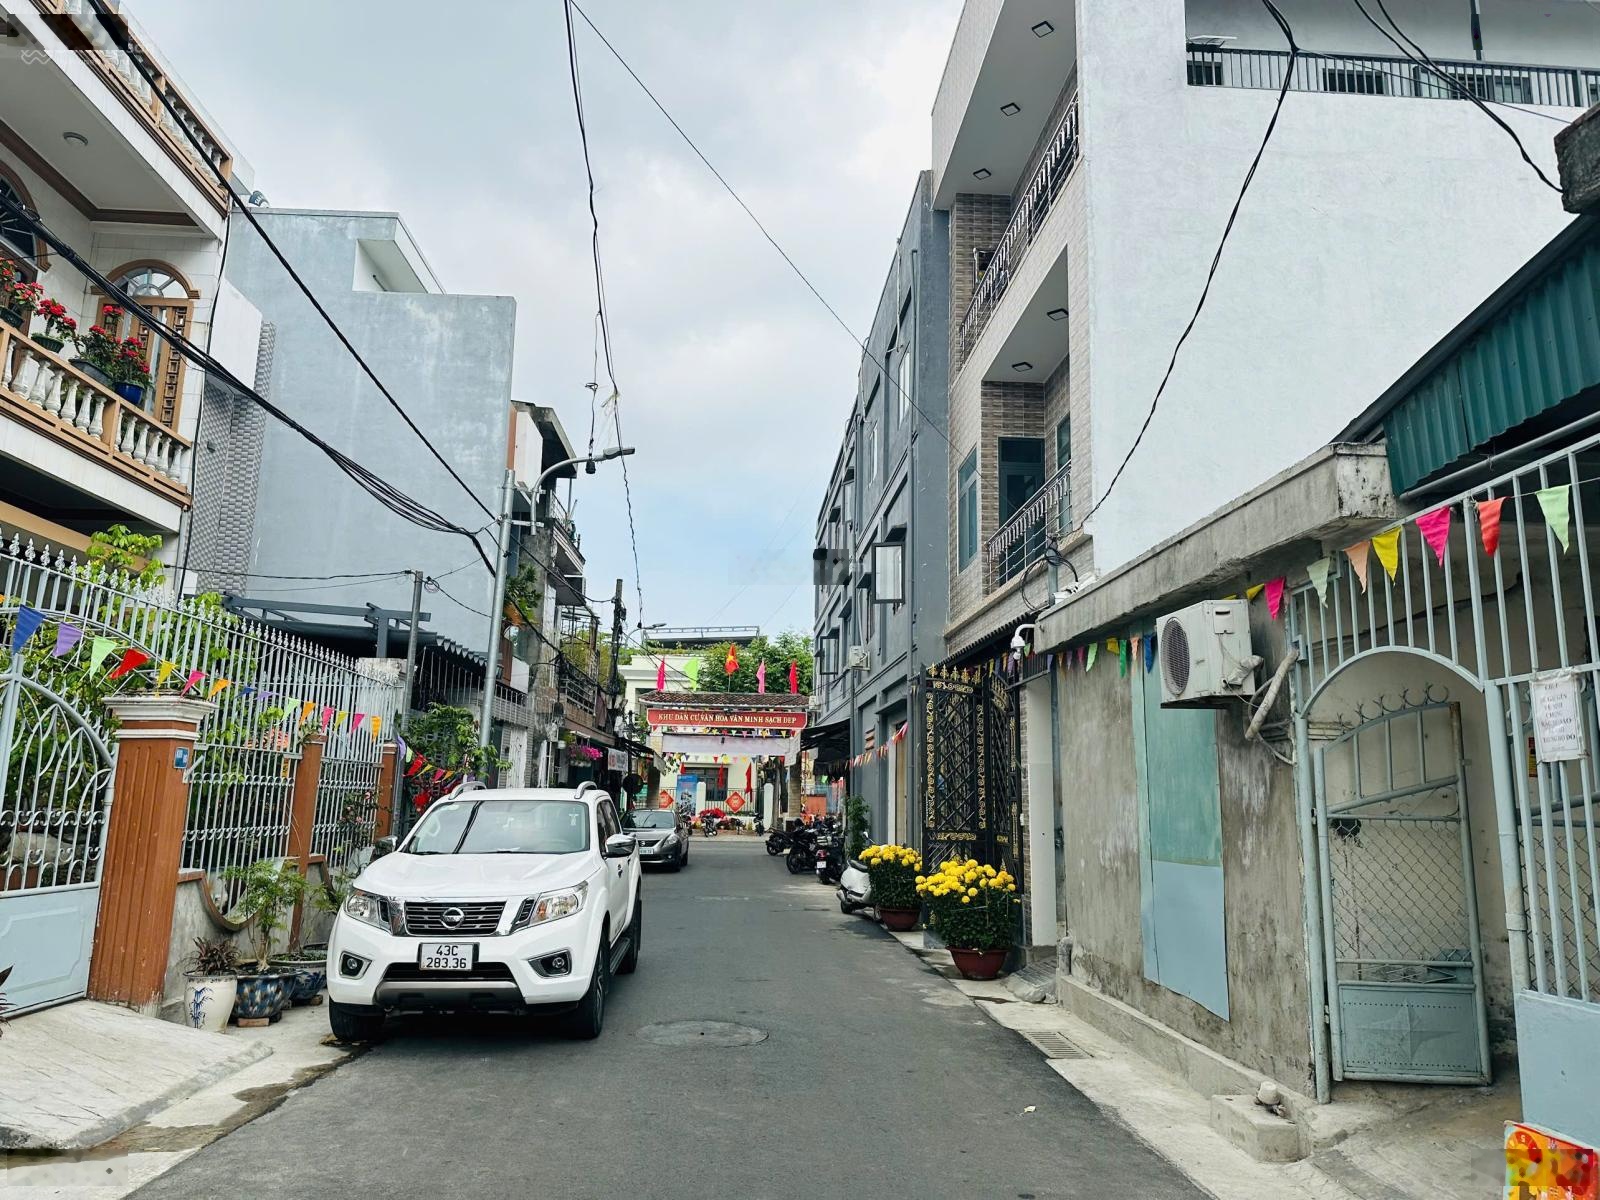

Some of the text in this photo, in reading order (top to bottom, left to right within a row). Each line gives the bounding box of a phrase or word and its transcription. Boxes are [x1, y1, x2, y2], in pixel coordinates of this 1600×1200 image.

[658, 713, 674, 721] KHU
[744, 715, 764, 723] MINH
[764, 716, 782, 725] SẠCH
[436, 944, 459, 956] 43C
[426, 957, 467, 969] 283.36
